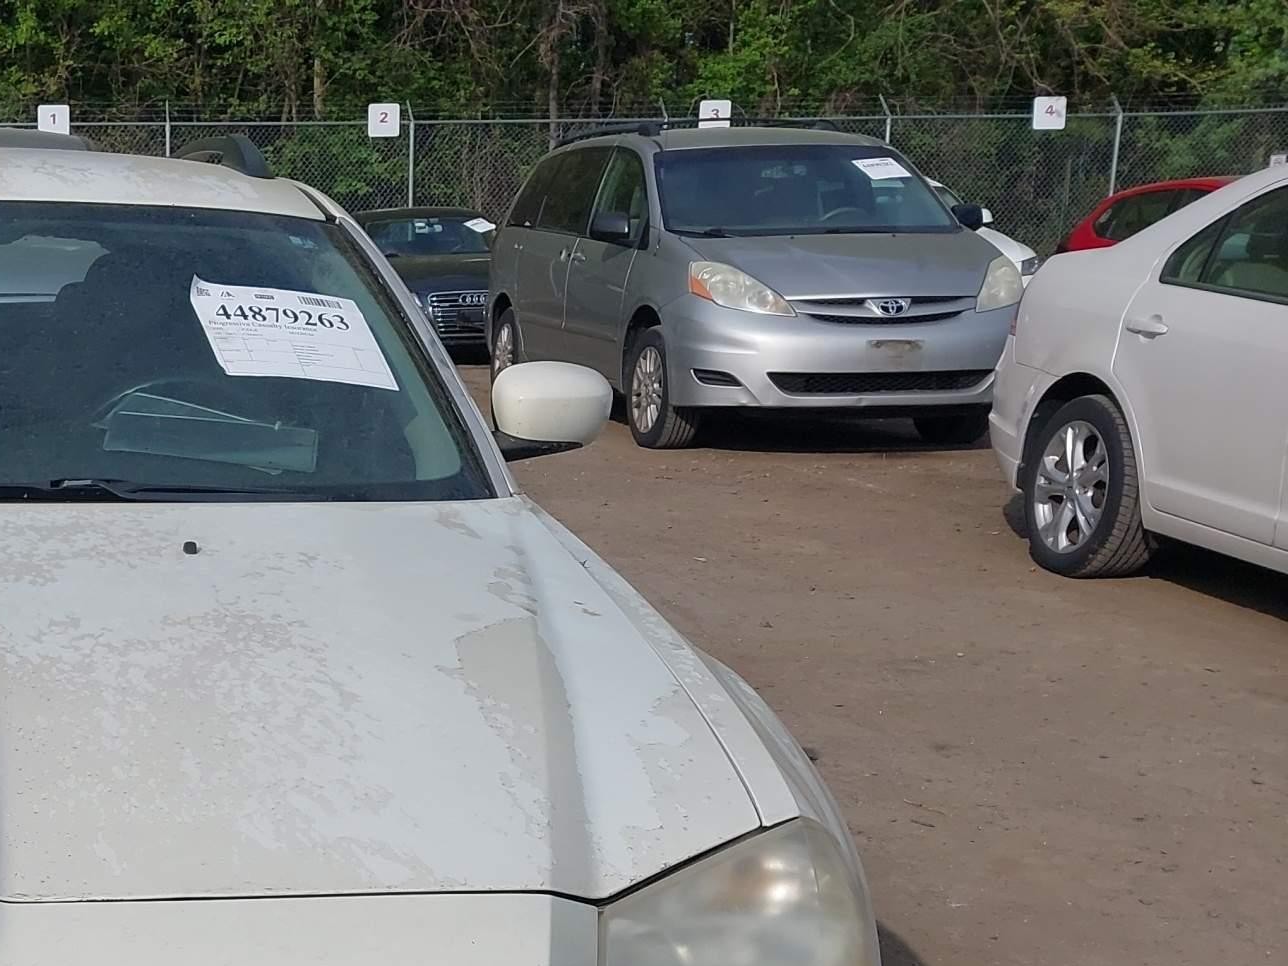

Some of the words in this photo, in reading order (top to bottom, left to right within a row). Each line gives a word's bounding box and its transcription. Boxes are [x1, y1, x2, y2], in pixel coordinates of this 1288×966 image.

[711, 108, 720, 119] 3
[1045, 104, 1056, 117] 4
[49, 113, 57, 125] 1
[379, 111, 389, 123] 2
[215, 304, 350, 331] 44879263
